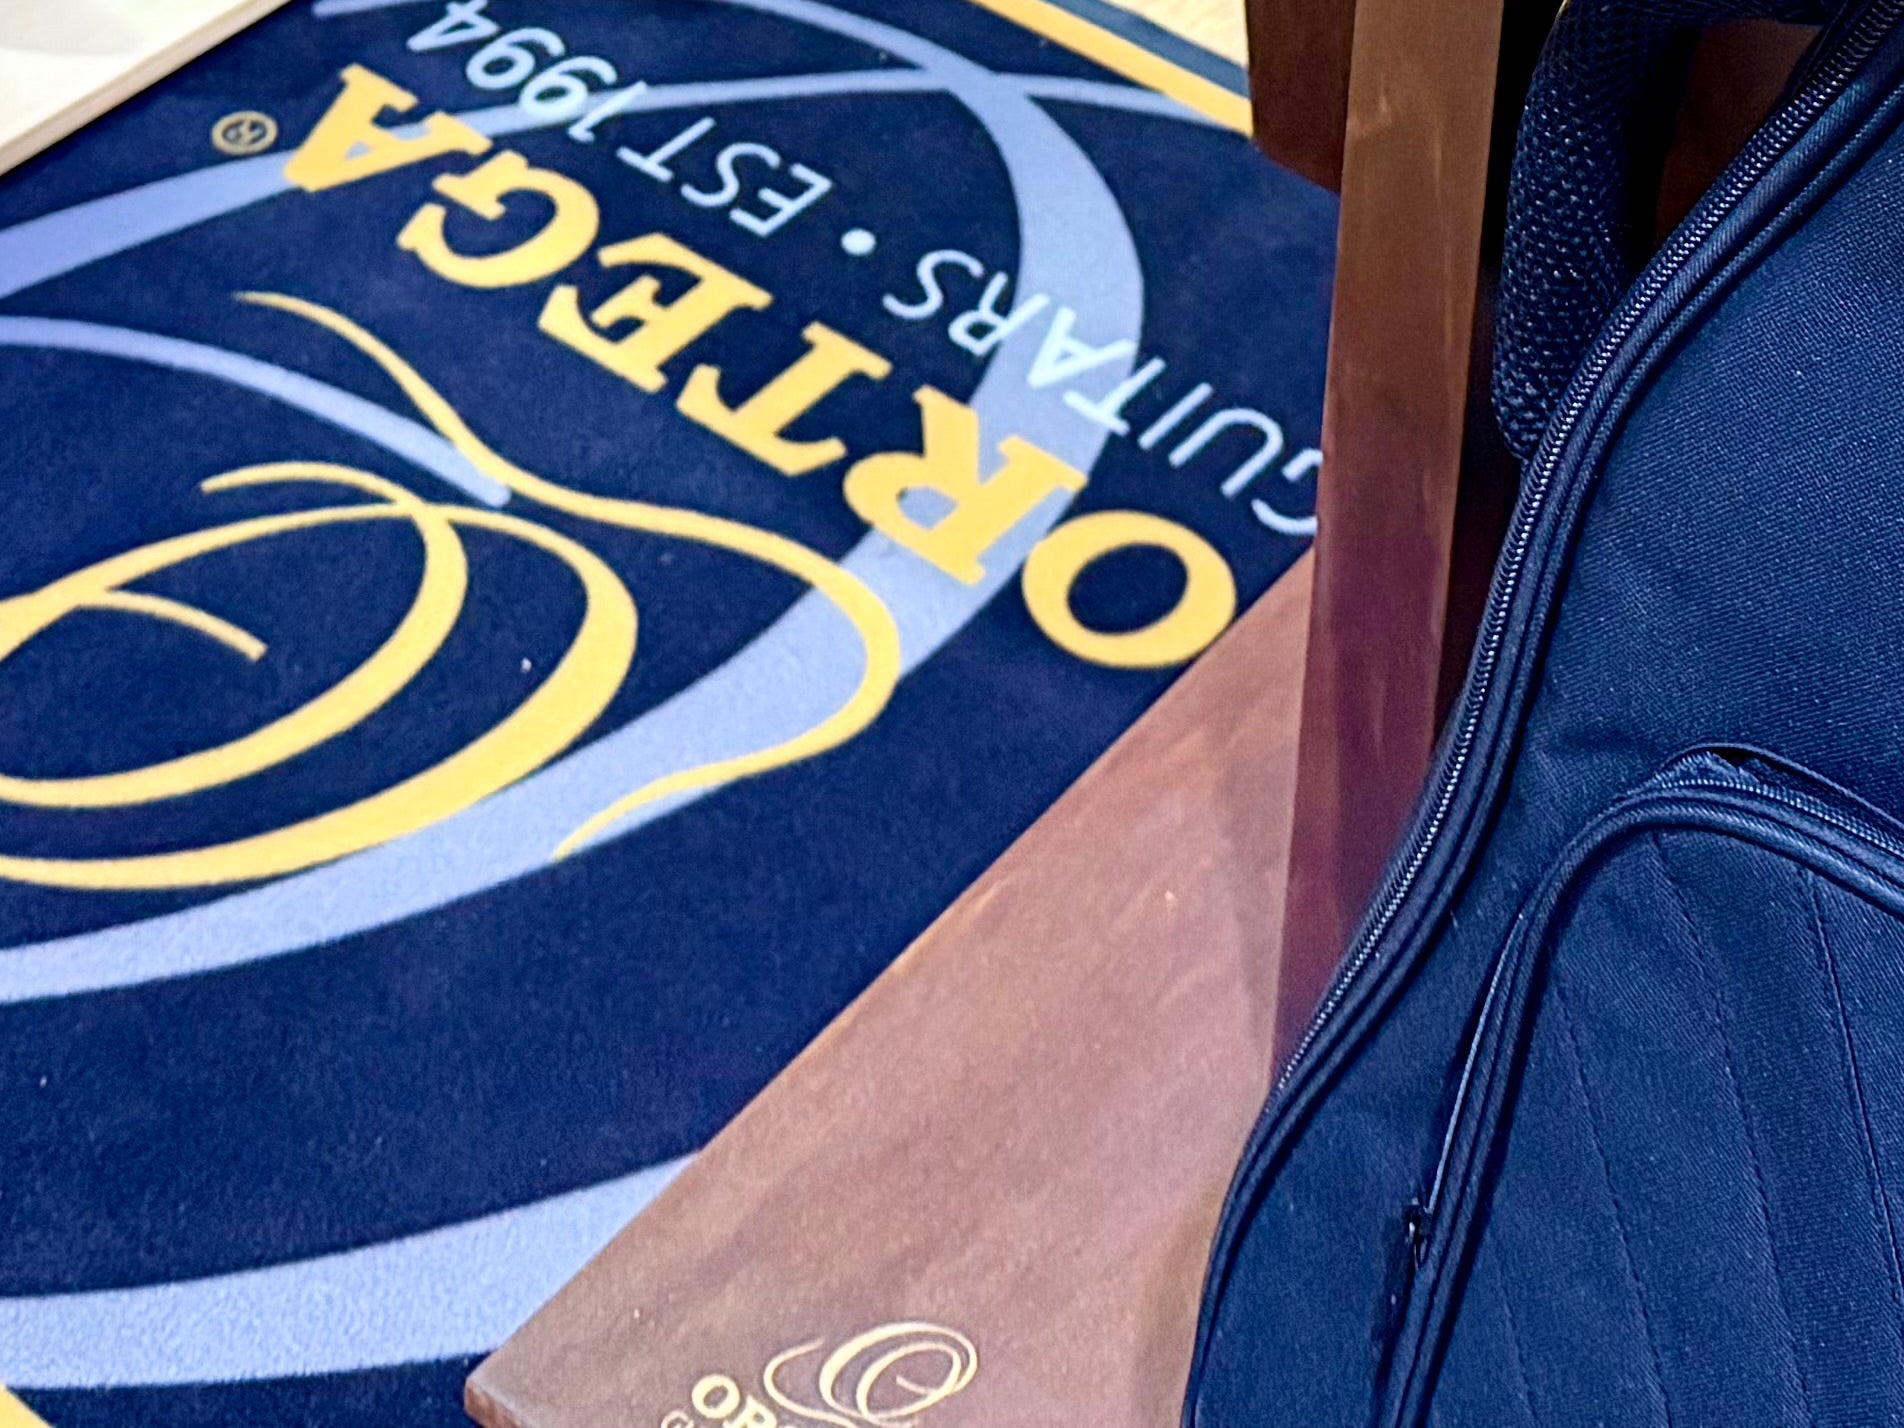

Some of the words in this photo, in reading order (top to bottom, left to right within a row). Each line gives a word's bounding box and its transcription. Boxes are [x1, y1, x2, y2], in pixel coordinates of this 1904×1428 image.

[616, 114, 834, 238] EST
[282, 62, 1238, 670] ORTEGA
[882, 244, 1322, 537] GUITARS
[691, 1373, 795, 1428] OR
